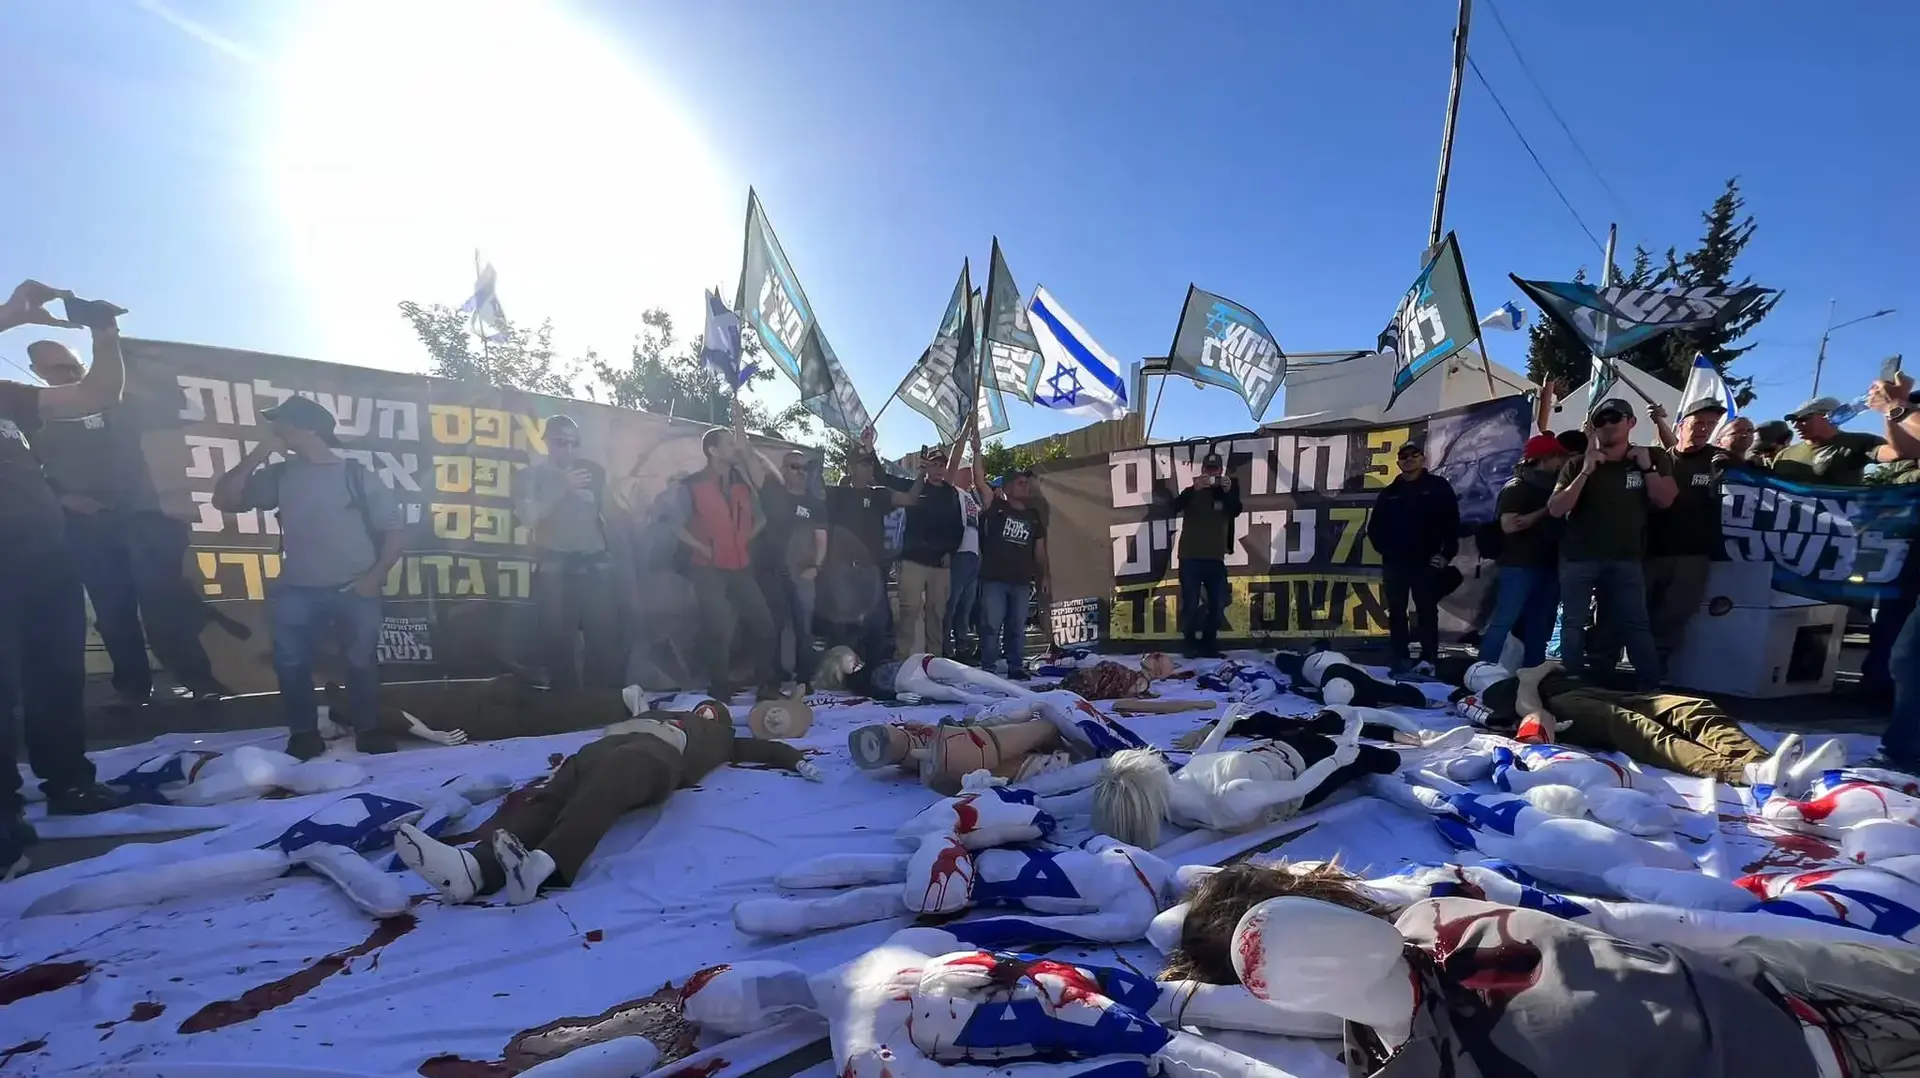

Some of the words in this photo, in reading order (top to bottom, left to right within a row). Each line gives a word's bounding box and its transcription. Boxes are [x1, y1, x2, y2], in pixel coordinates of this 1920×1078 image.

[432, 455, 530, 497] פס
[1109, 434, 1349, 508] חודשים
[1364, 428, 1410, 488] 3
[431, 503, 530, 545] פס
[1722, 484, 1860, 537] אחים
[1722, 526, 1911, 583] לנשק
[1051, 612, 1087, 629] אחים
[1249, 579, 1391, 632] אשם
[377, 643, 433, 662] לנשק
[1053, 622, 1098, 648] לנשק
